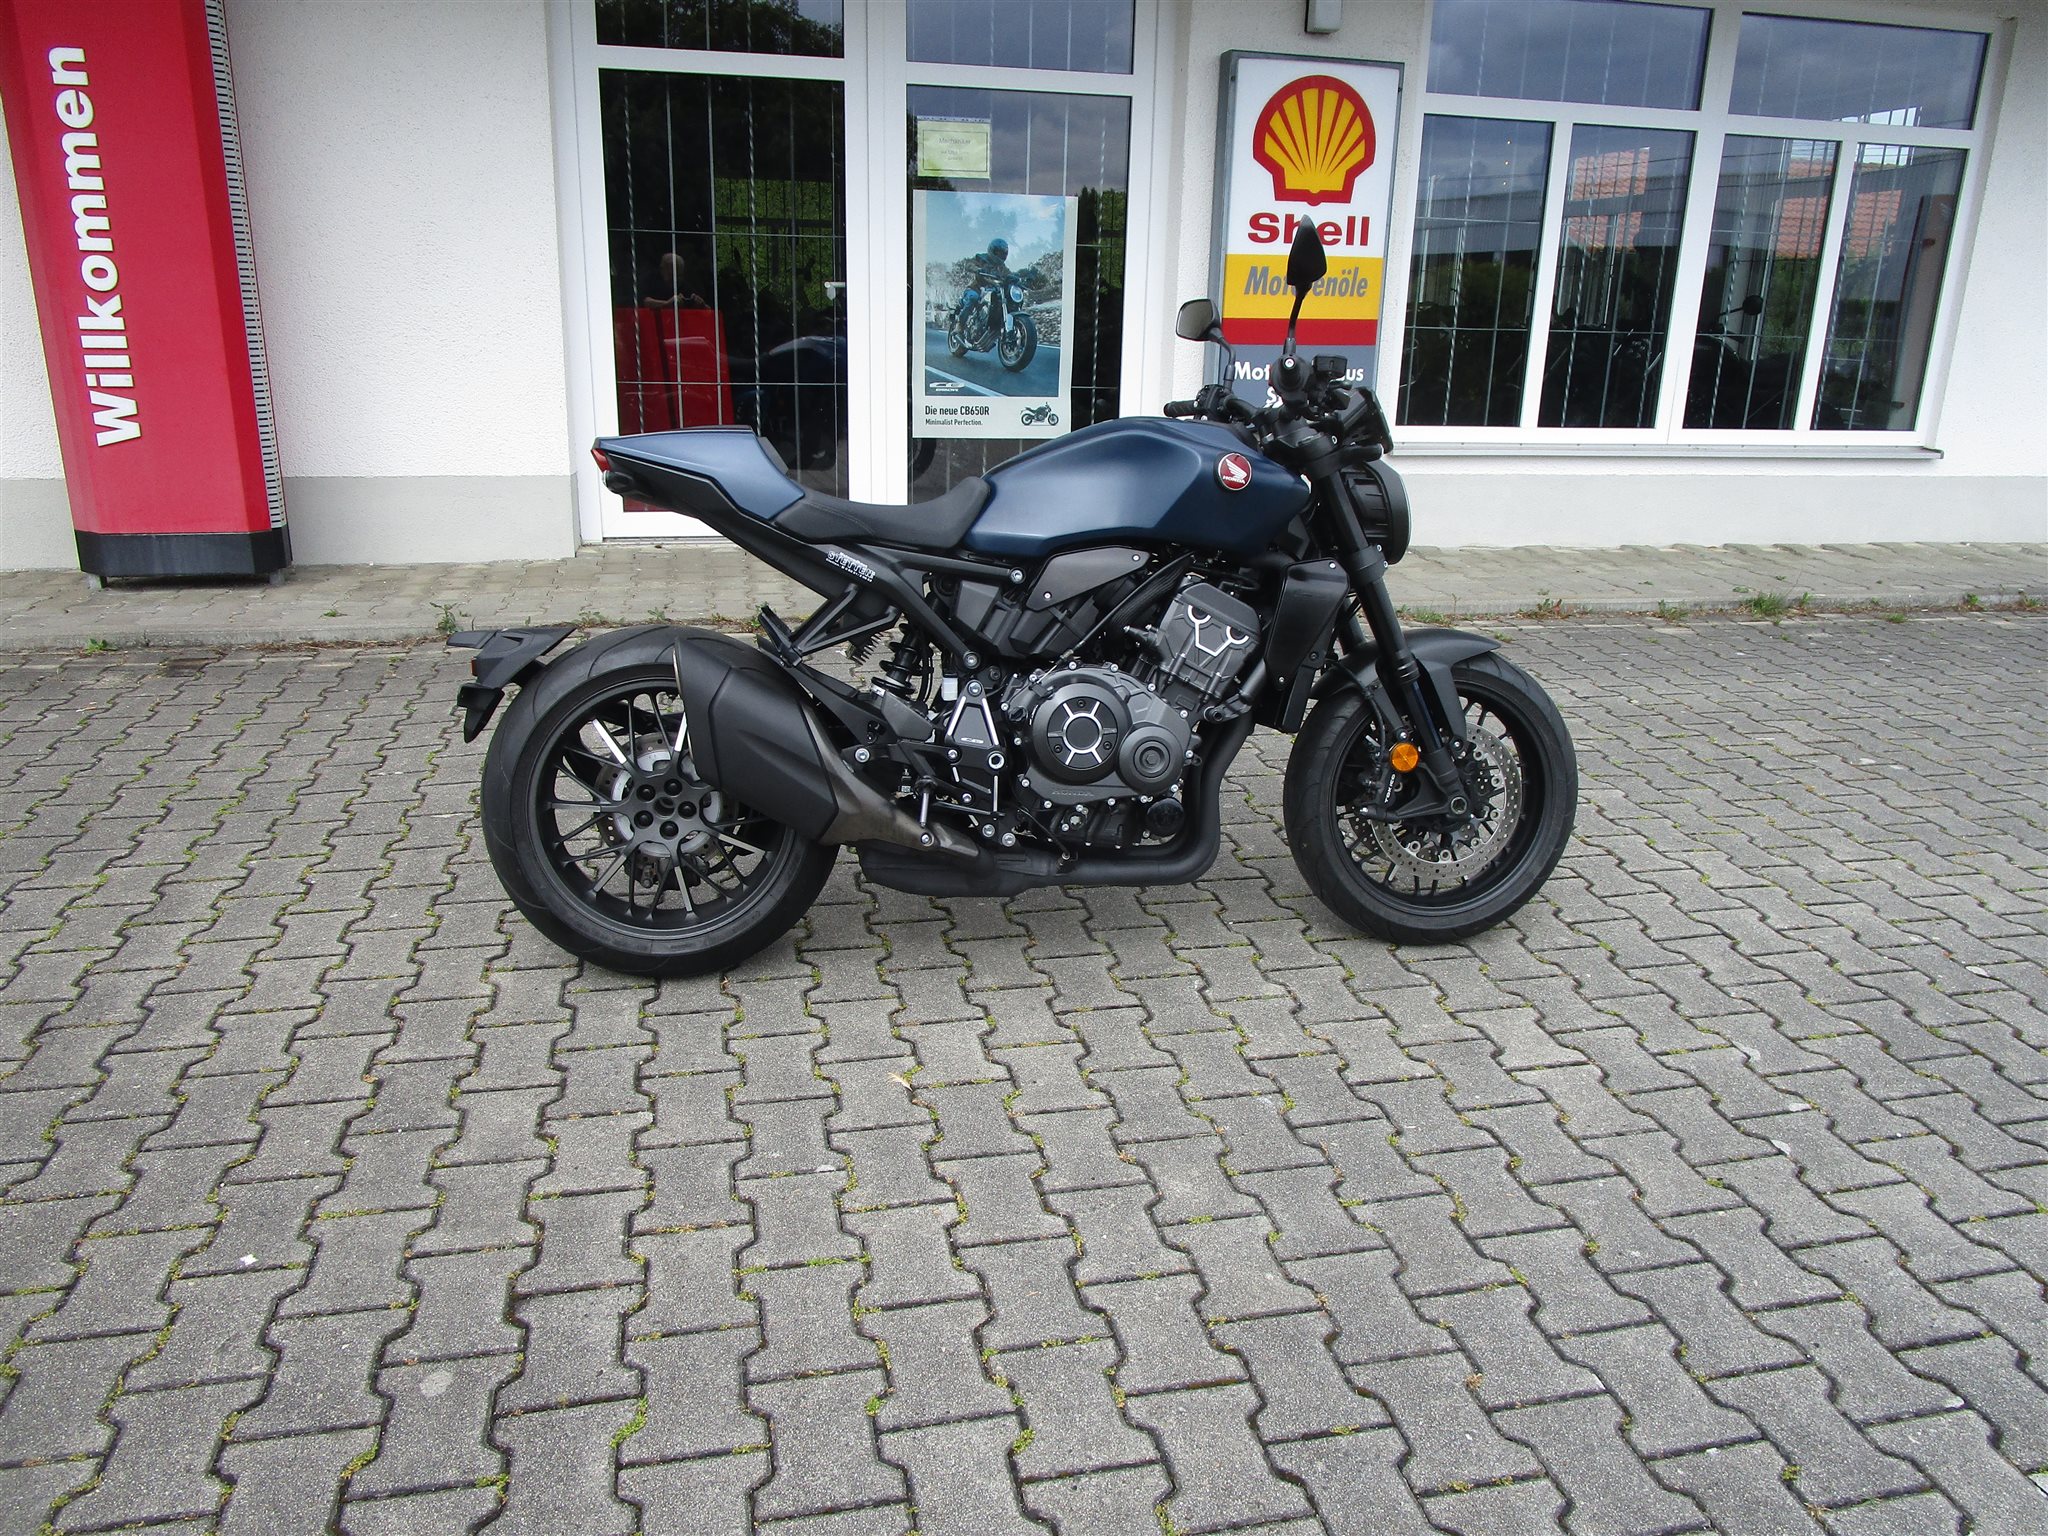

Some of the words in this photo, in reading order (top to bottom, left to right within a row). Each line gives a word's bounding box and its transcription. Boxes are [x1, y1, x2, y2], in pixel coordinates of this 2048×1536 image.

[1248, 212, 1370, 246] Shell
[48, 45, 142, 448] Willkommen
[1244, 266, 1368, 297] Motenöle
[925, 405, 938, 415] Die
[939, 407, 959, 416] neue
[960, 405, 990, 416] CB650R
[925, 418, 953, 426] Minimalist
